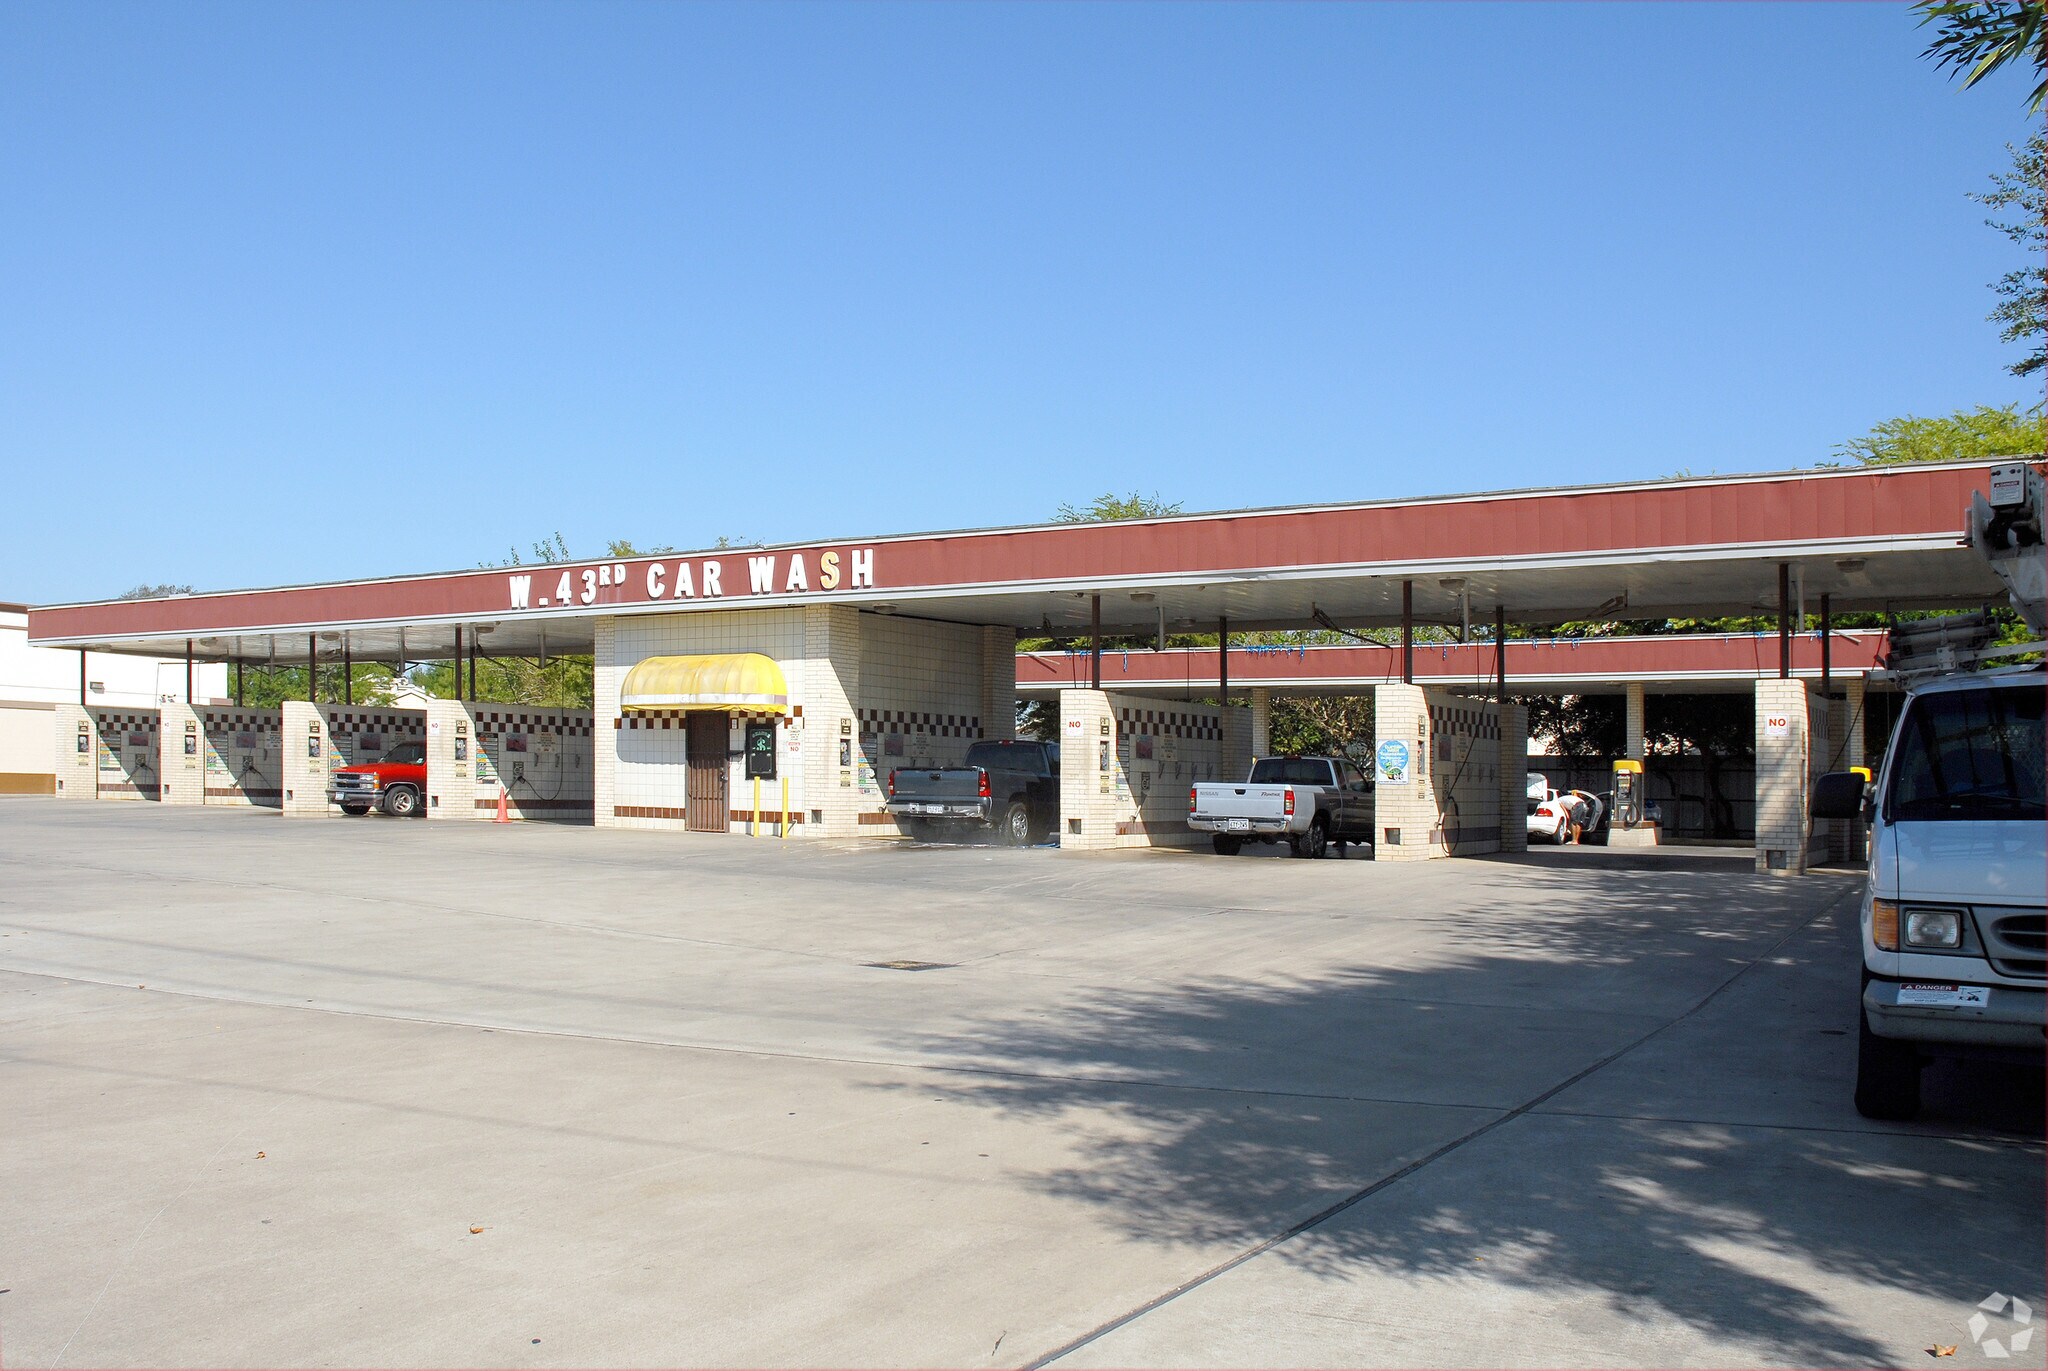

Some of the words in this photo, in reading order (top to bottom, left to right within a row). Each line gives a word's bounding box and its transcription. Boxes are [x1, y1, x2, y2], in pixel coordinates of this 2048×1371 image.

[509, 575, 548, 608] W.
[556, 564, 626, 606] 43RD
[647, 561, 722, 599] CAR
[748, 549, 873, 593] WASH
[1769, 718, 1786, 726] NO
